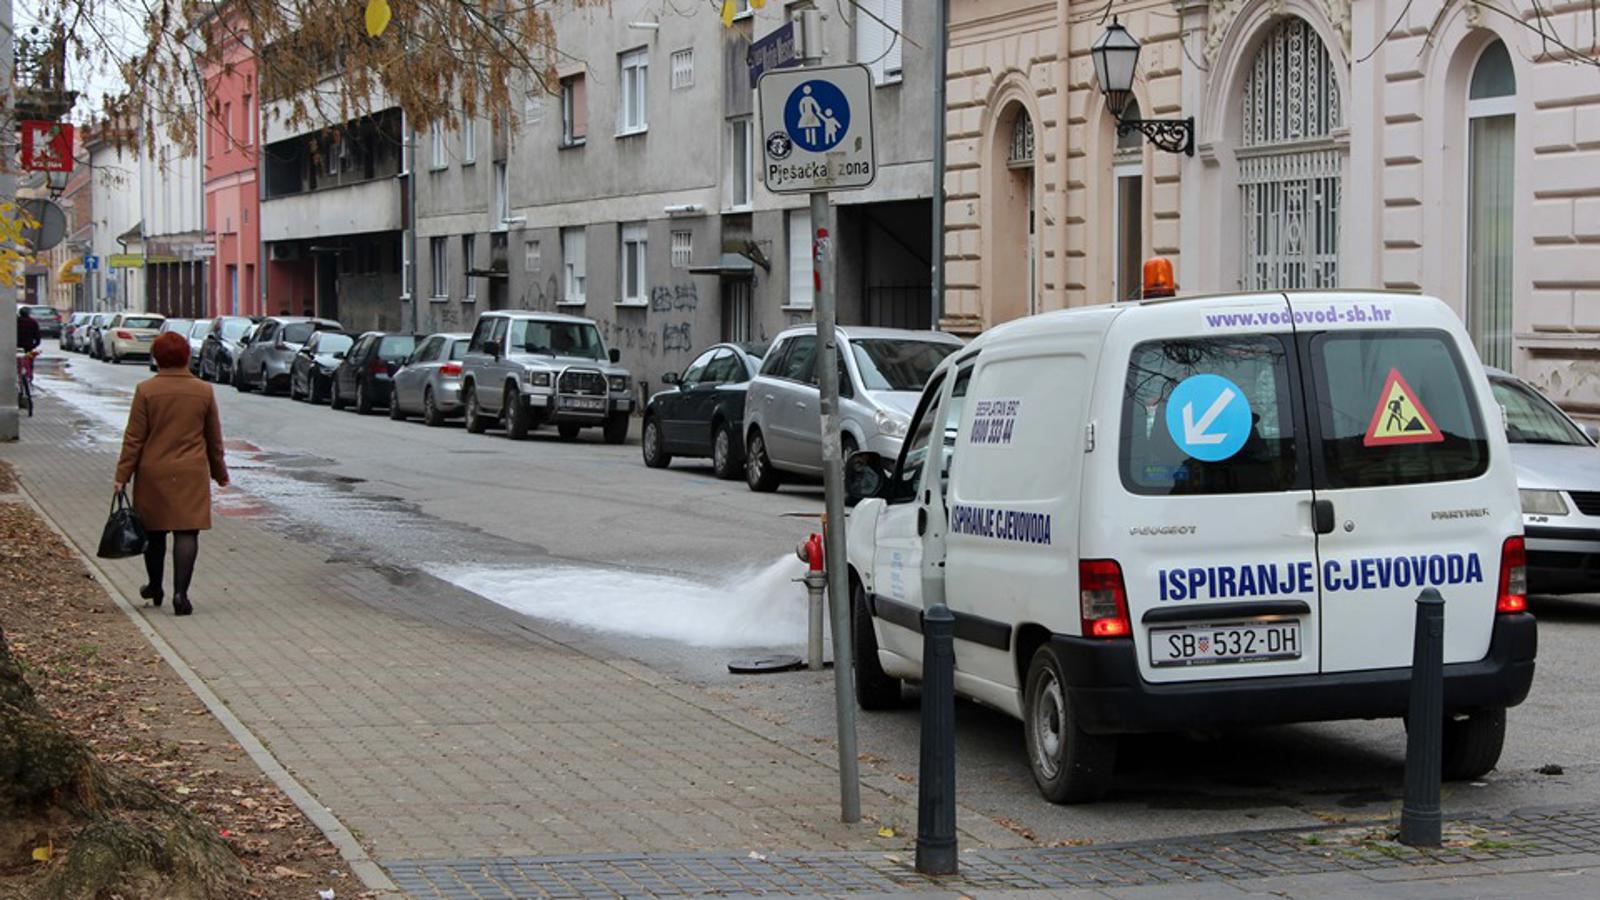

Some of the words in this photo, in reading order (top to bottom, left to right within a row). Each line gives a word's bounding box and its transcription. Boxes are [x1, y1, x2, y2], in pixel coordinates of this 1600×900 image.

[769, 161, 828, 185] Pješačka
[838, 161, 870, 176] zona
[1206, 304, 1392, 328] www.vodovod-sb.hr
[952, 505, 995, 538] ISPIRANJE
[996, 510, 1052, 545] CJEVOVODA
[1431, 508, 1491, 520] PARTNER
[1129, 525, 1197, 536] PEUGEOT
[1159, 561, 1314, 601] ISPIRANJE
[1323, 552, 1484, 591] CJEVOVODA
[1168, 634, 1196, 658] SB
[1213, 628, 1296, 657] 532-DH
